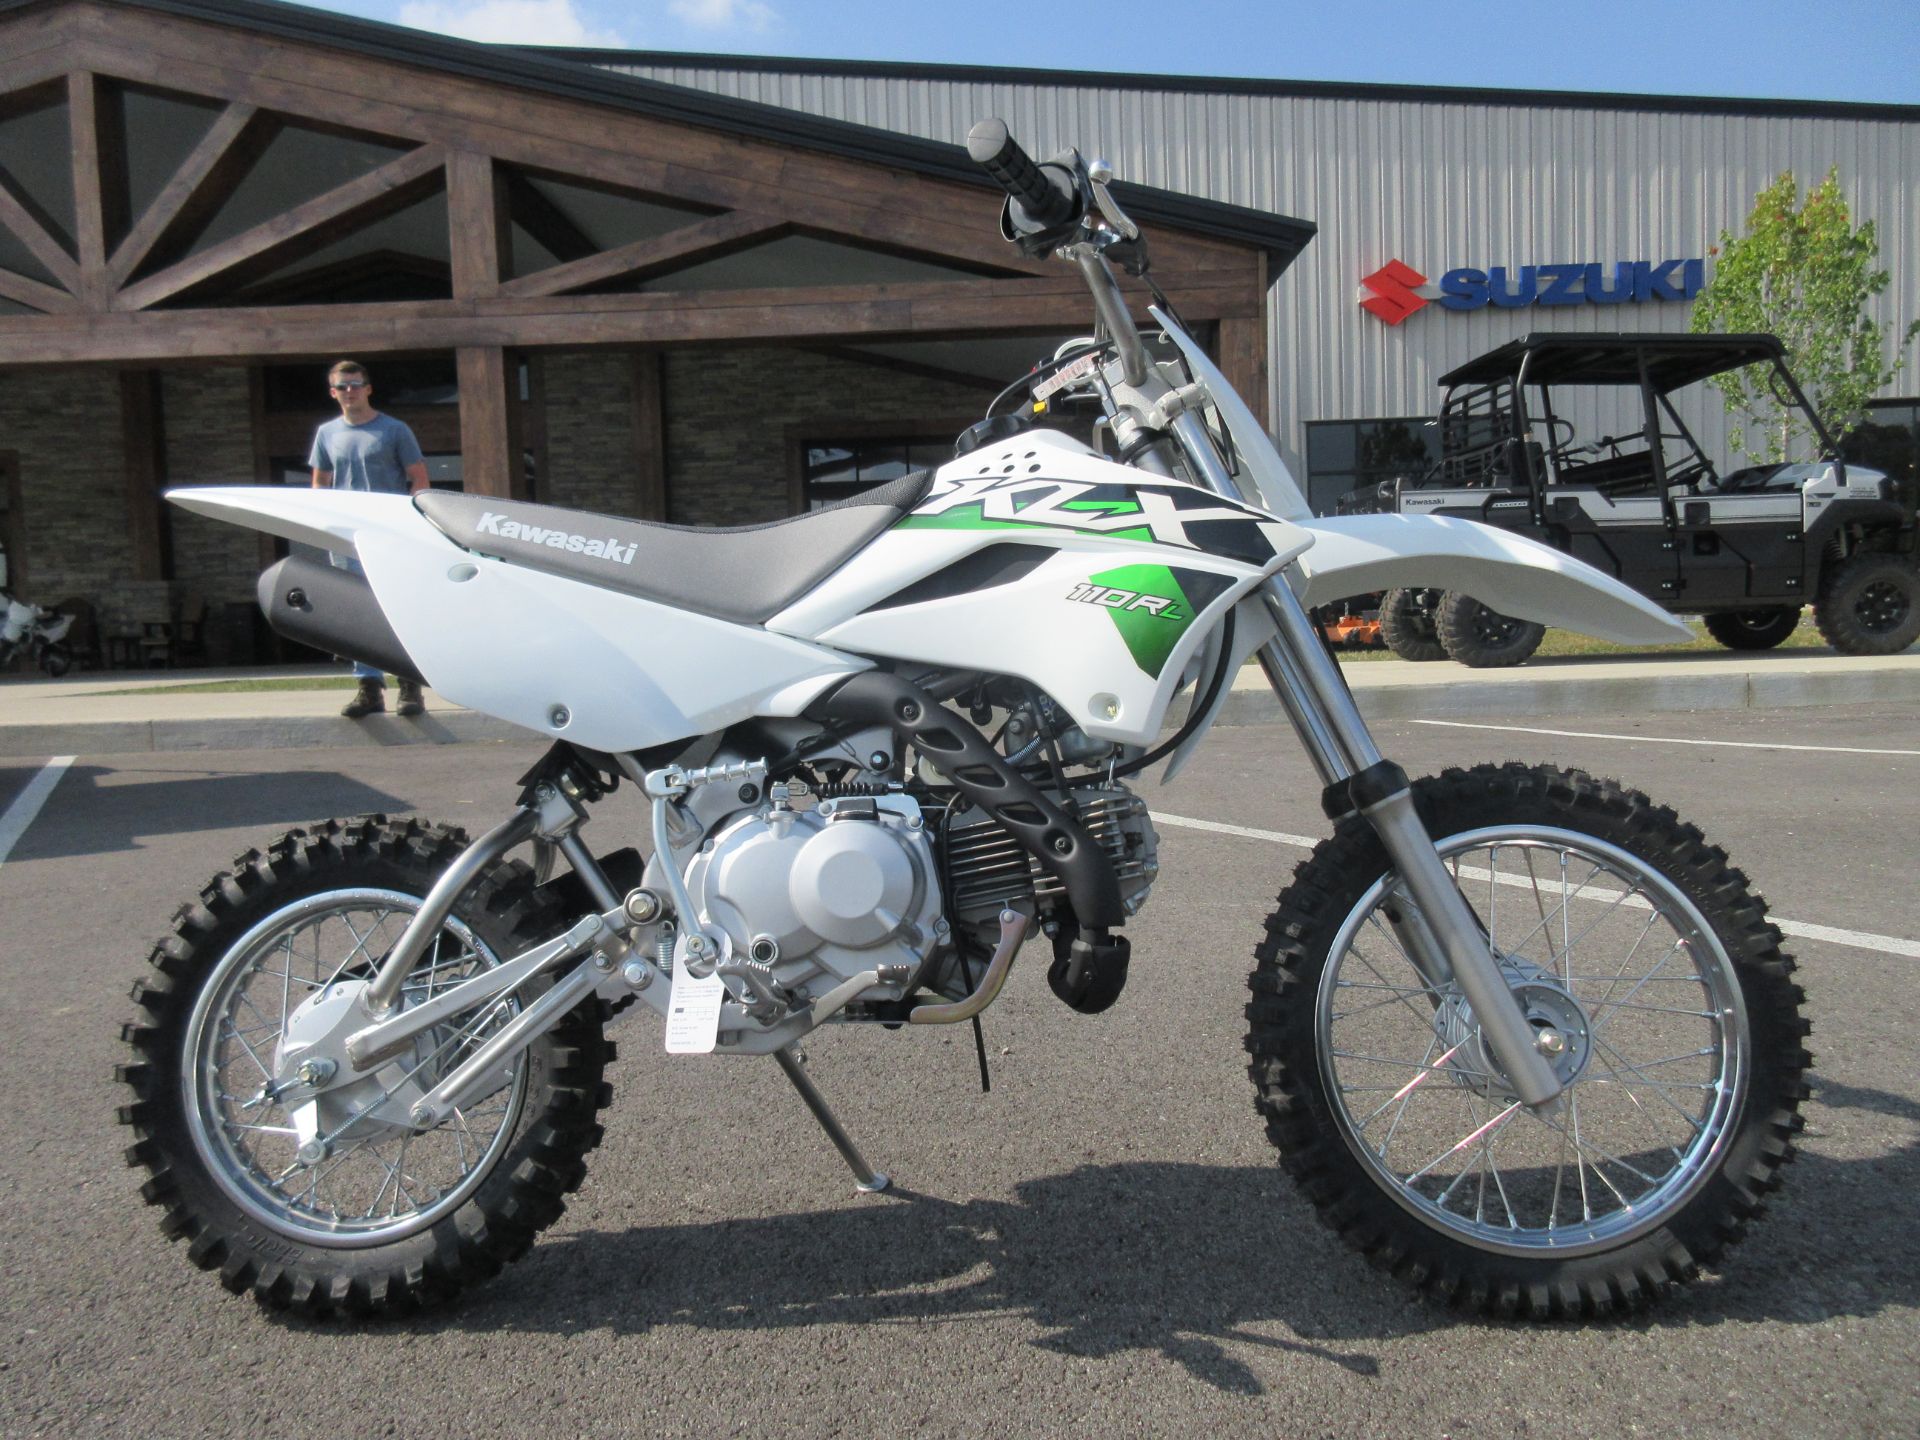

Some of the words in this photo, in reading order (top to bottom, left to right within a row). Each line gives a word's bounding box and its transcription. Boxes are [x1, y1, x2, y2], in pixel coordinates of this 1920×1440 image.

[1440, 258, 1703, 311] SUZUKI
[911, 477, 1267, 551] KLX
[1405, 498, 1445, 506] Kawasaki
[475, 511, 639, 565] Kawasaki
